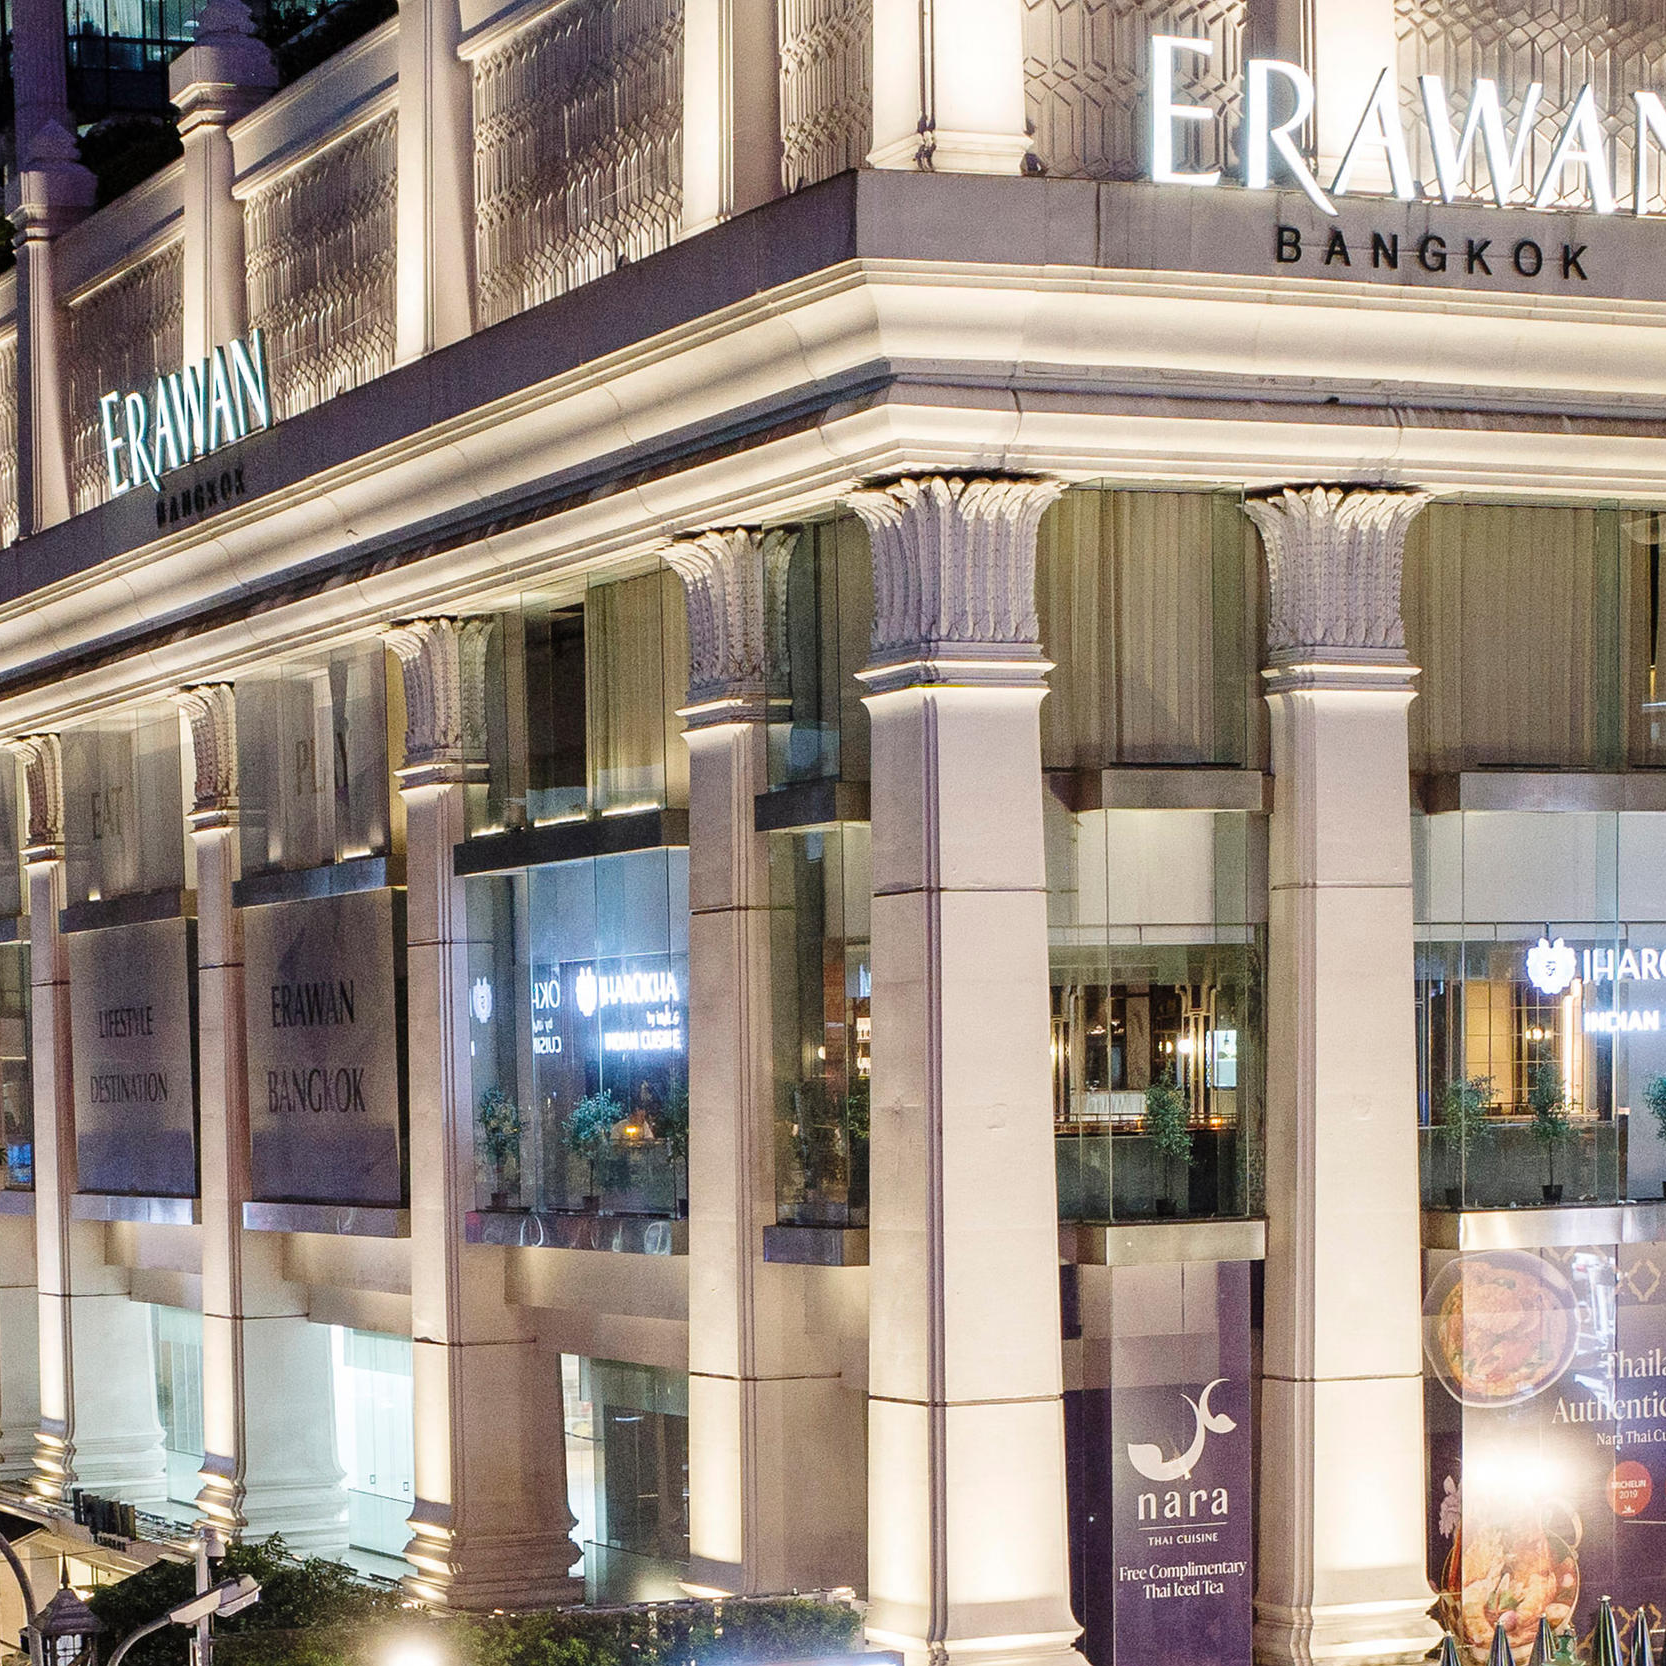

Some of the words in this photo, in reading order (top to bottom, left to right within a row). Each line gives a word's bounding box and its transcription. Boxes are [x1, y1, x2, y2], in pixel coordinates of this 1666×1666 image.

[1276, 226, 1590, 281] BANGKOK
[100, 328, 271, 497] ERAWAN
[270, 980, 355, 1028] ERAWAN
[98, 1006, 154, 1038] LIFESTYLE
[90, 1072, 168, 1103] DESTINATION
[266, 1067, 366, 1113] BANGKOK
[1596, 1432, 1623, 1447] Nara
[1611, 1479, 1647, 1489] MICHELIN
[1619, 1489, 1639, 1500] 2019
[1138, 1487, 1229, 1521] nara
[1148, 1536, 1173, 1547] THAI
[1176, 1532, 1219, 1545] CUISINE
[1119, 1565, 1147, 1582] Free
[1149, 1559, 1247, 1581] Complimentary
[1143, 1583, 1172, 1600] Thai
[1173, 1581, 1201, 1598] Iced
[1202, 1579, 1225, 1596] Tea
